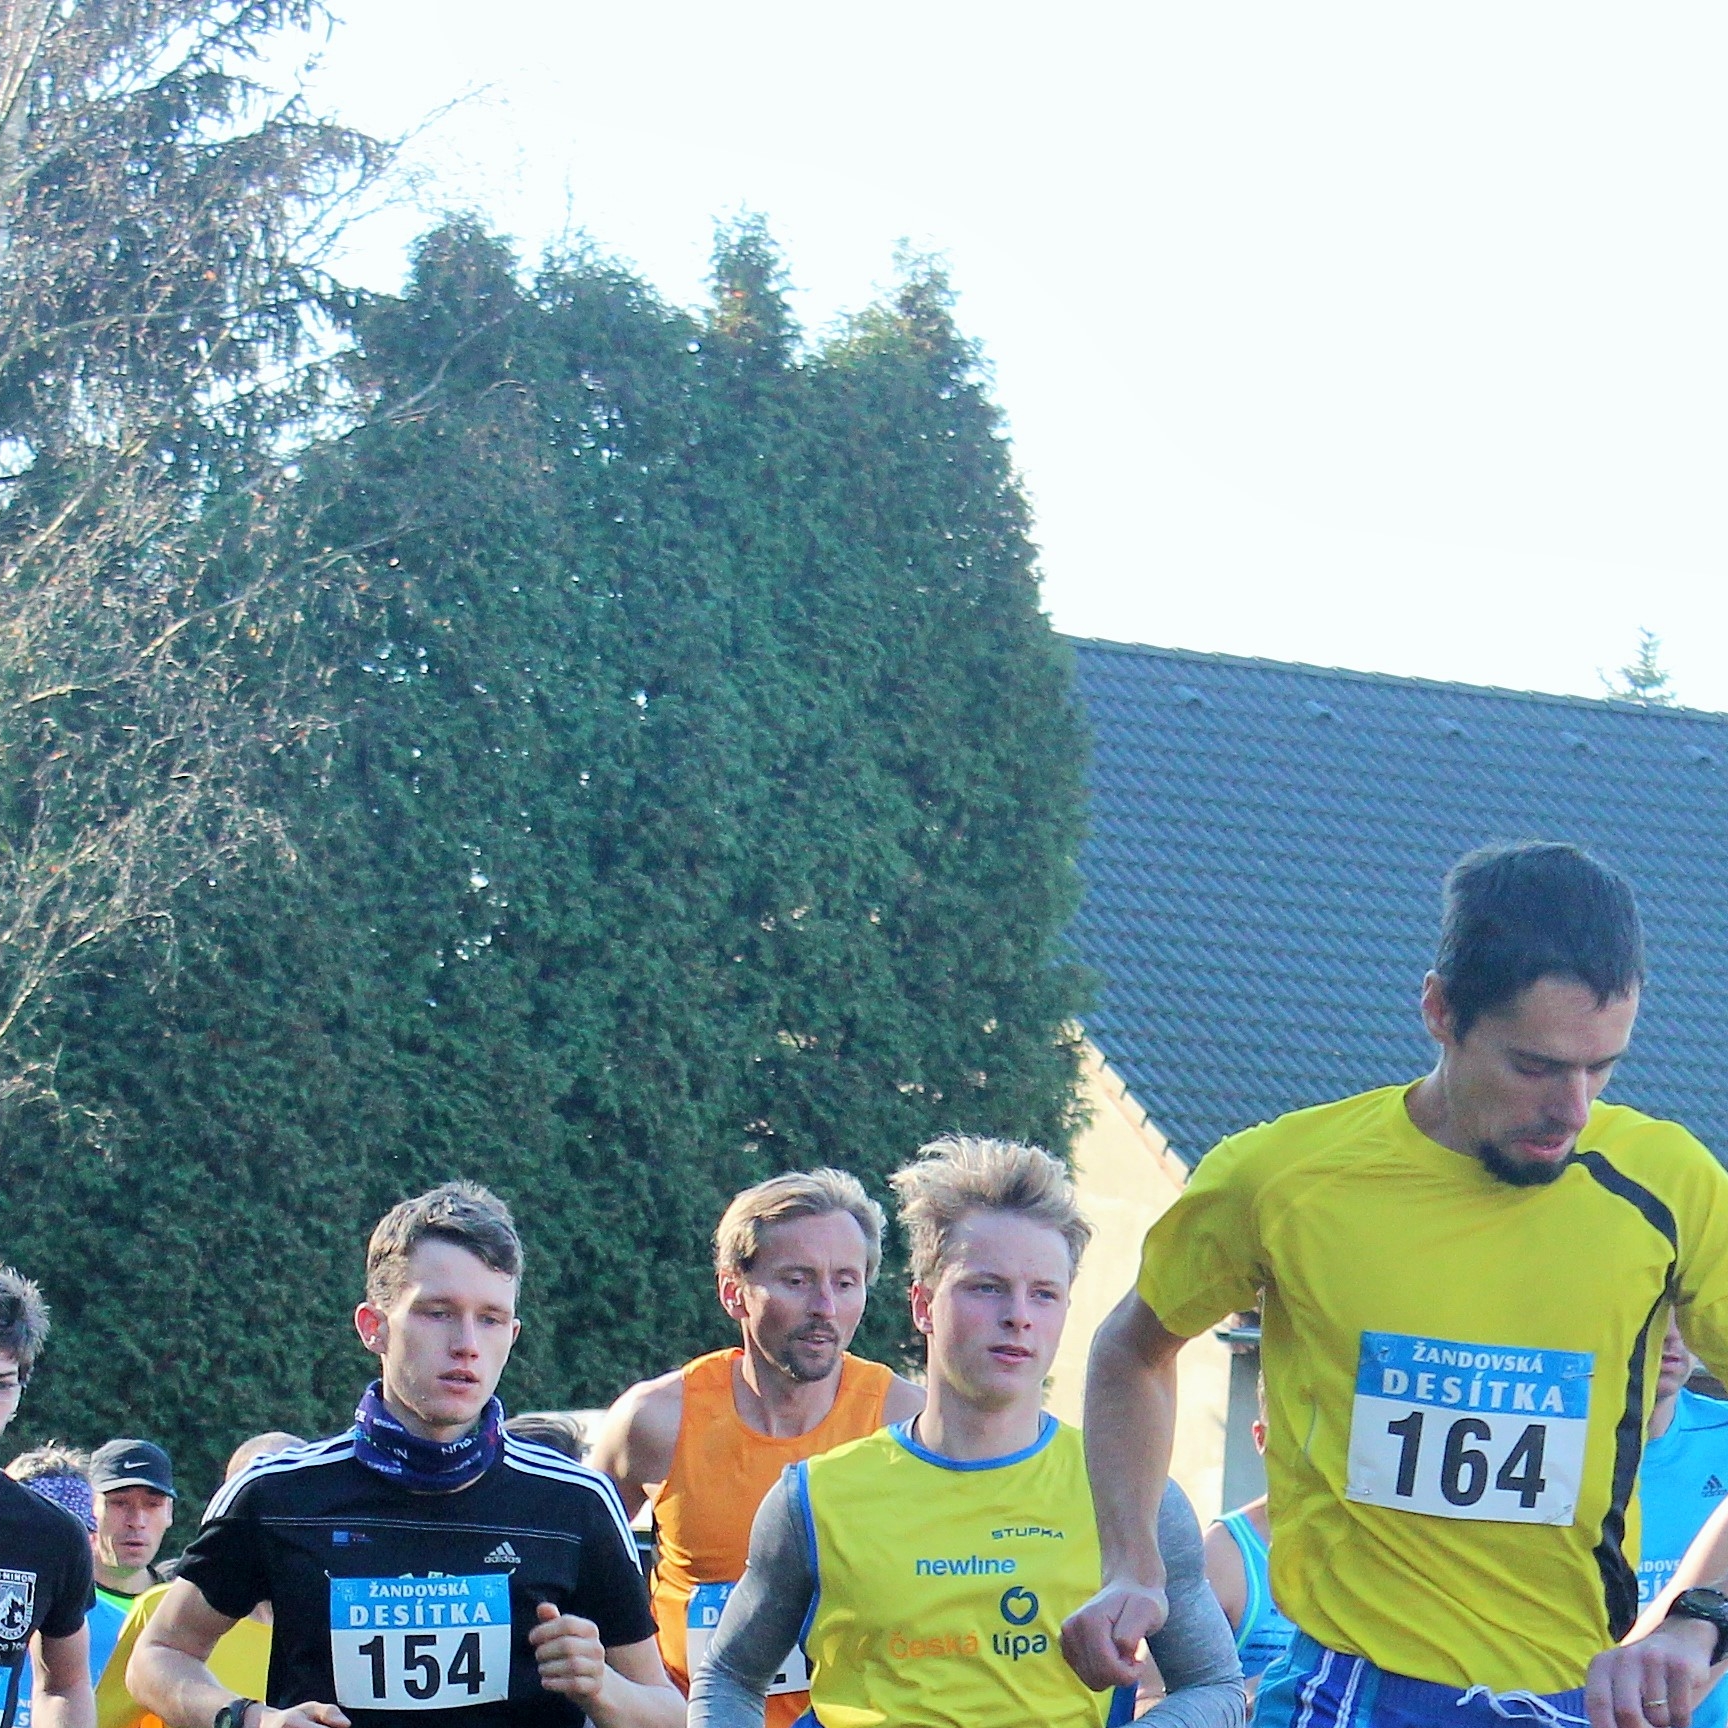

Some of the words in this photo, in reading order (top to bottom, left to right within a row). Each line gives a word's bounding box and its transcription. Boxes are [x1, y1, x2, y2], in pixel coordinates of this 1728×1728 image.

[1412, 1341, 1544, 1374] ŽANDOVSKÁ
[1382, 1368, 1564, 1413] DESÍTKA
[1387, 1410, 1547, 1508] 164
[991, 1527, 1064, 1540] STUPKA
[484, 1555, 521, 1564] adidas
[915, 1555, 1016, 1576] newline
[369, 1579, 470, 1598] ŽANDOVSKÁ
[349, 1598, 492, 1627] DESÍTKA
[889, 1630, 979, 1660] Česká
[358, 1632, 486, 1700] 154
